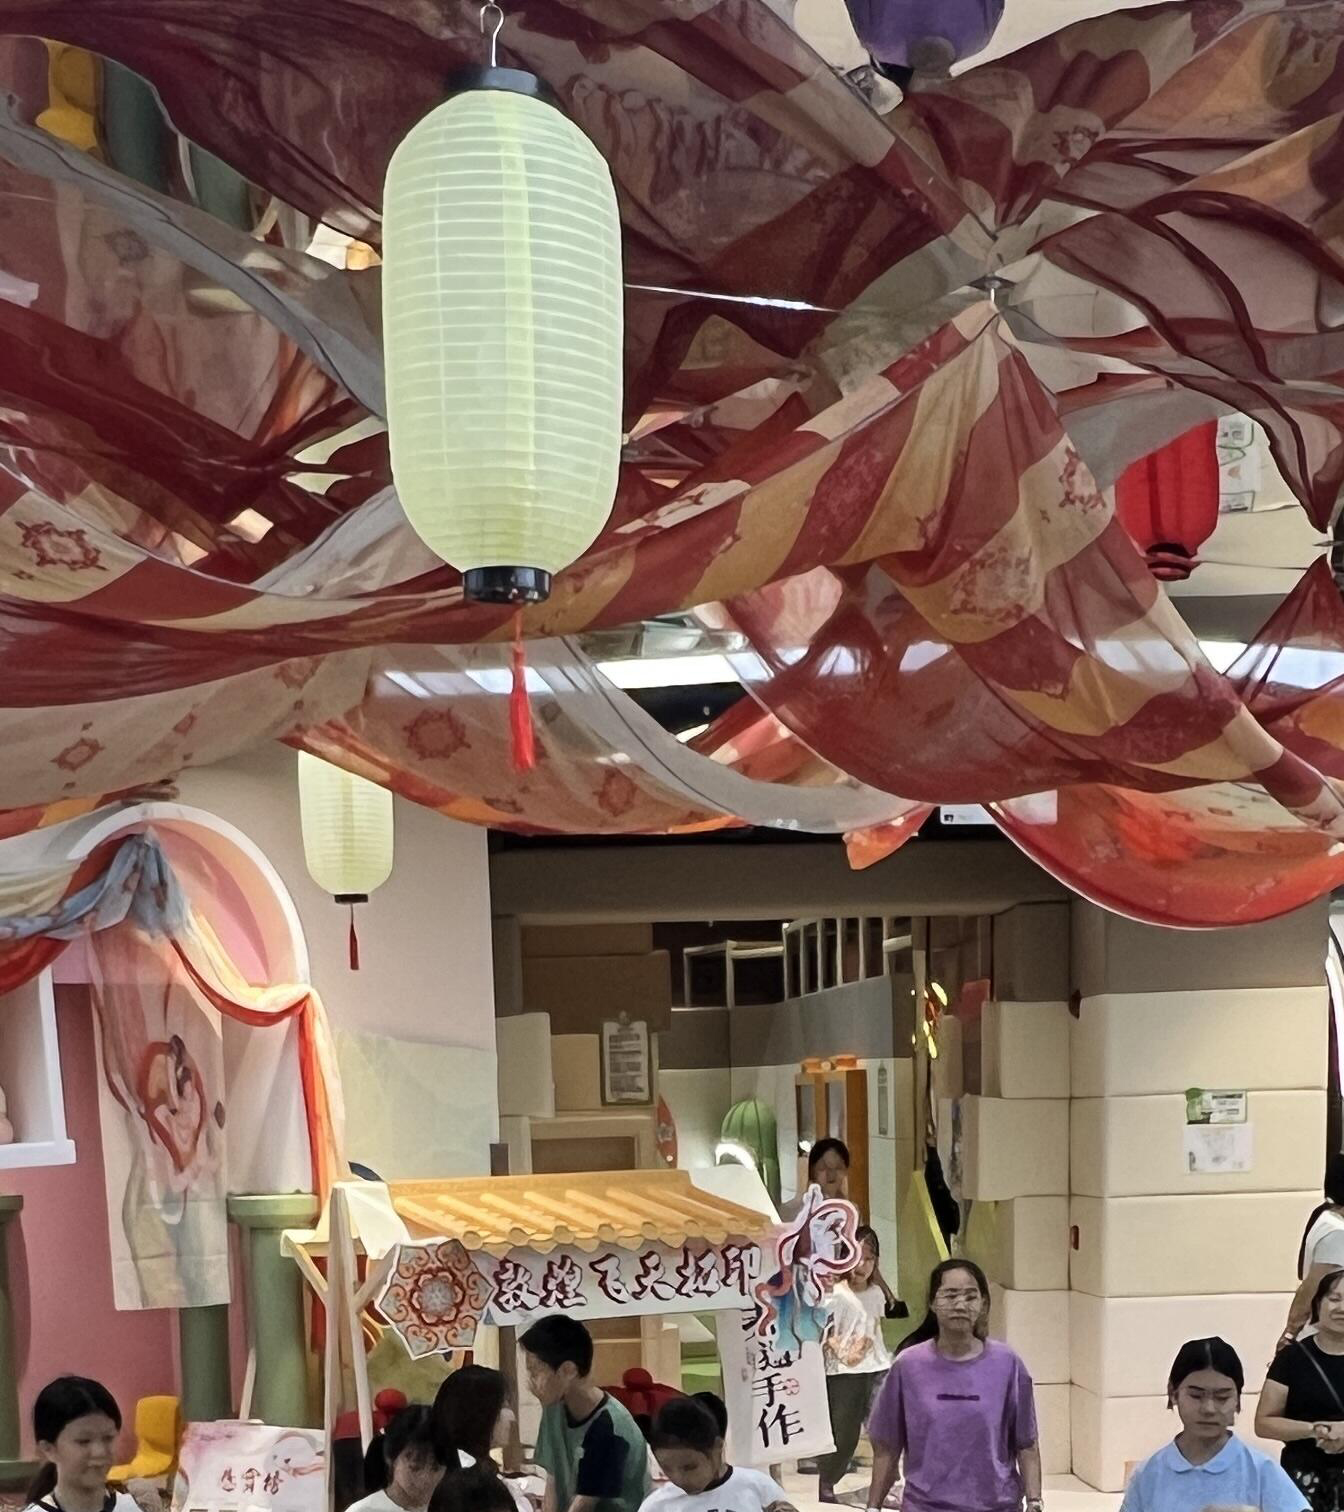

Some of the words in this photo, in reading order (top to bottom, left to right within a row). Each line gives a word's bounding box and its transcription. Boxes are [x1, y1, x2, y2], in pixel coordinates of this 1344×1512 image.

[493, 1245, 761, 1312] 敦煌飞天拓印
